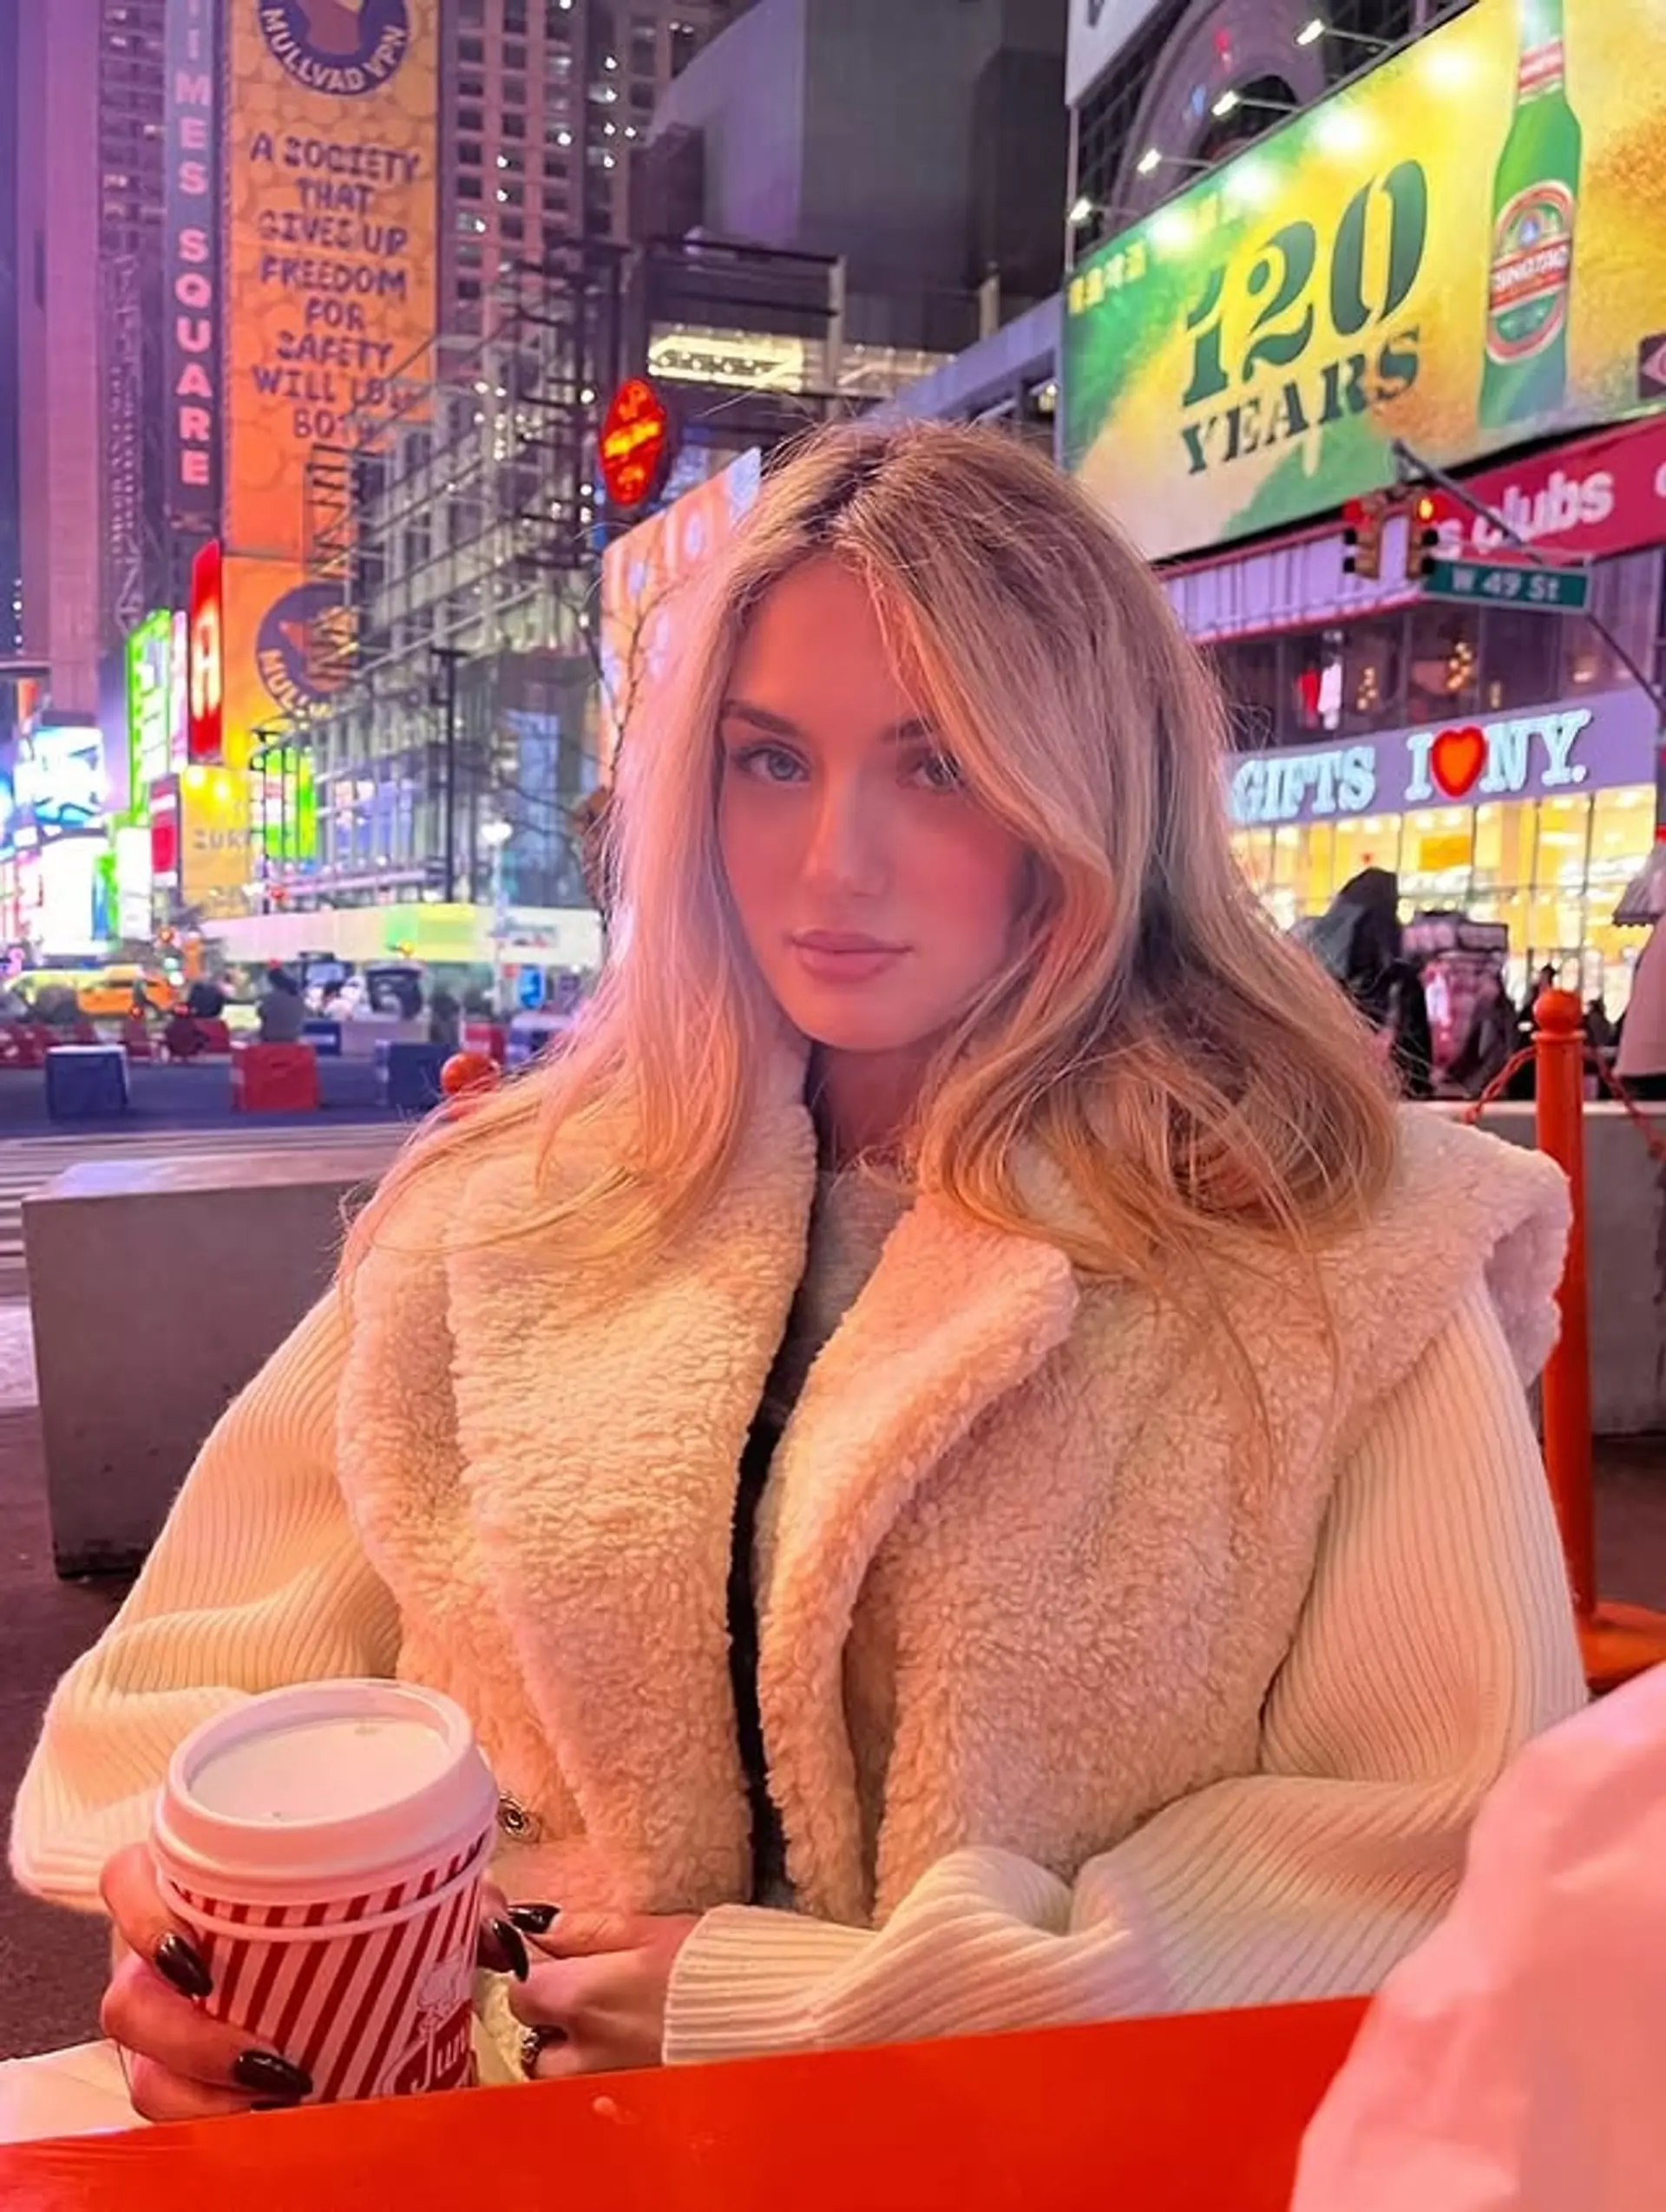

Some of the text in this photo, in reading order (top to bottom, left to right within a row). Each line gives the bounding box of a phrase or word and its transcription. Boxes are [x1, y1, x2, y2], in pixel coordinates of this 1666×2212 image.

[262, 9, 407, 91] MULLVAD VPN
[250, 132, 421, 185] A SOCIETY
[295, 176, 376, 217] THAT
[259, 208, 409, 259] GIVES UP
[261, 253, 408, 303] FREEDOM
[1182, 159, 1427, 408] 120
[306, 296, 366, 332] FOR
[174, 227, 213, 487] SQUARE
[276, 329, 393, 373] SAFETY
[251, 363, 337, 403] WILL
[1181, 324, 1420, 474] YEARS
[1472, 471, 1614, 555] clubs
[1453, 568, 1560, 601] W 49 St
[1230, 745, 1377, 824] GIFTS
